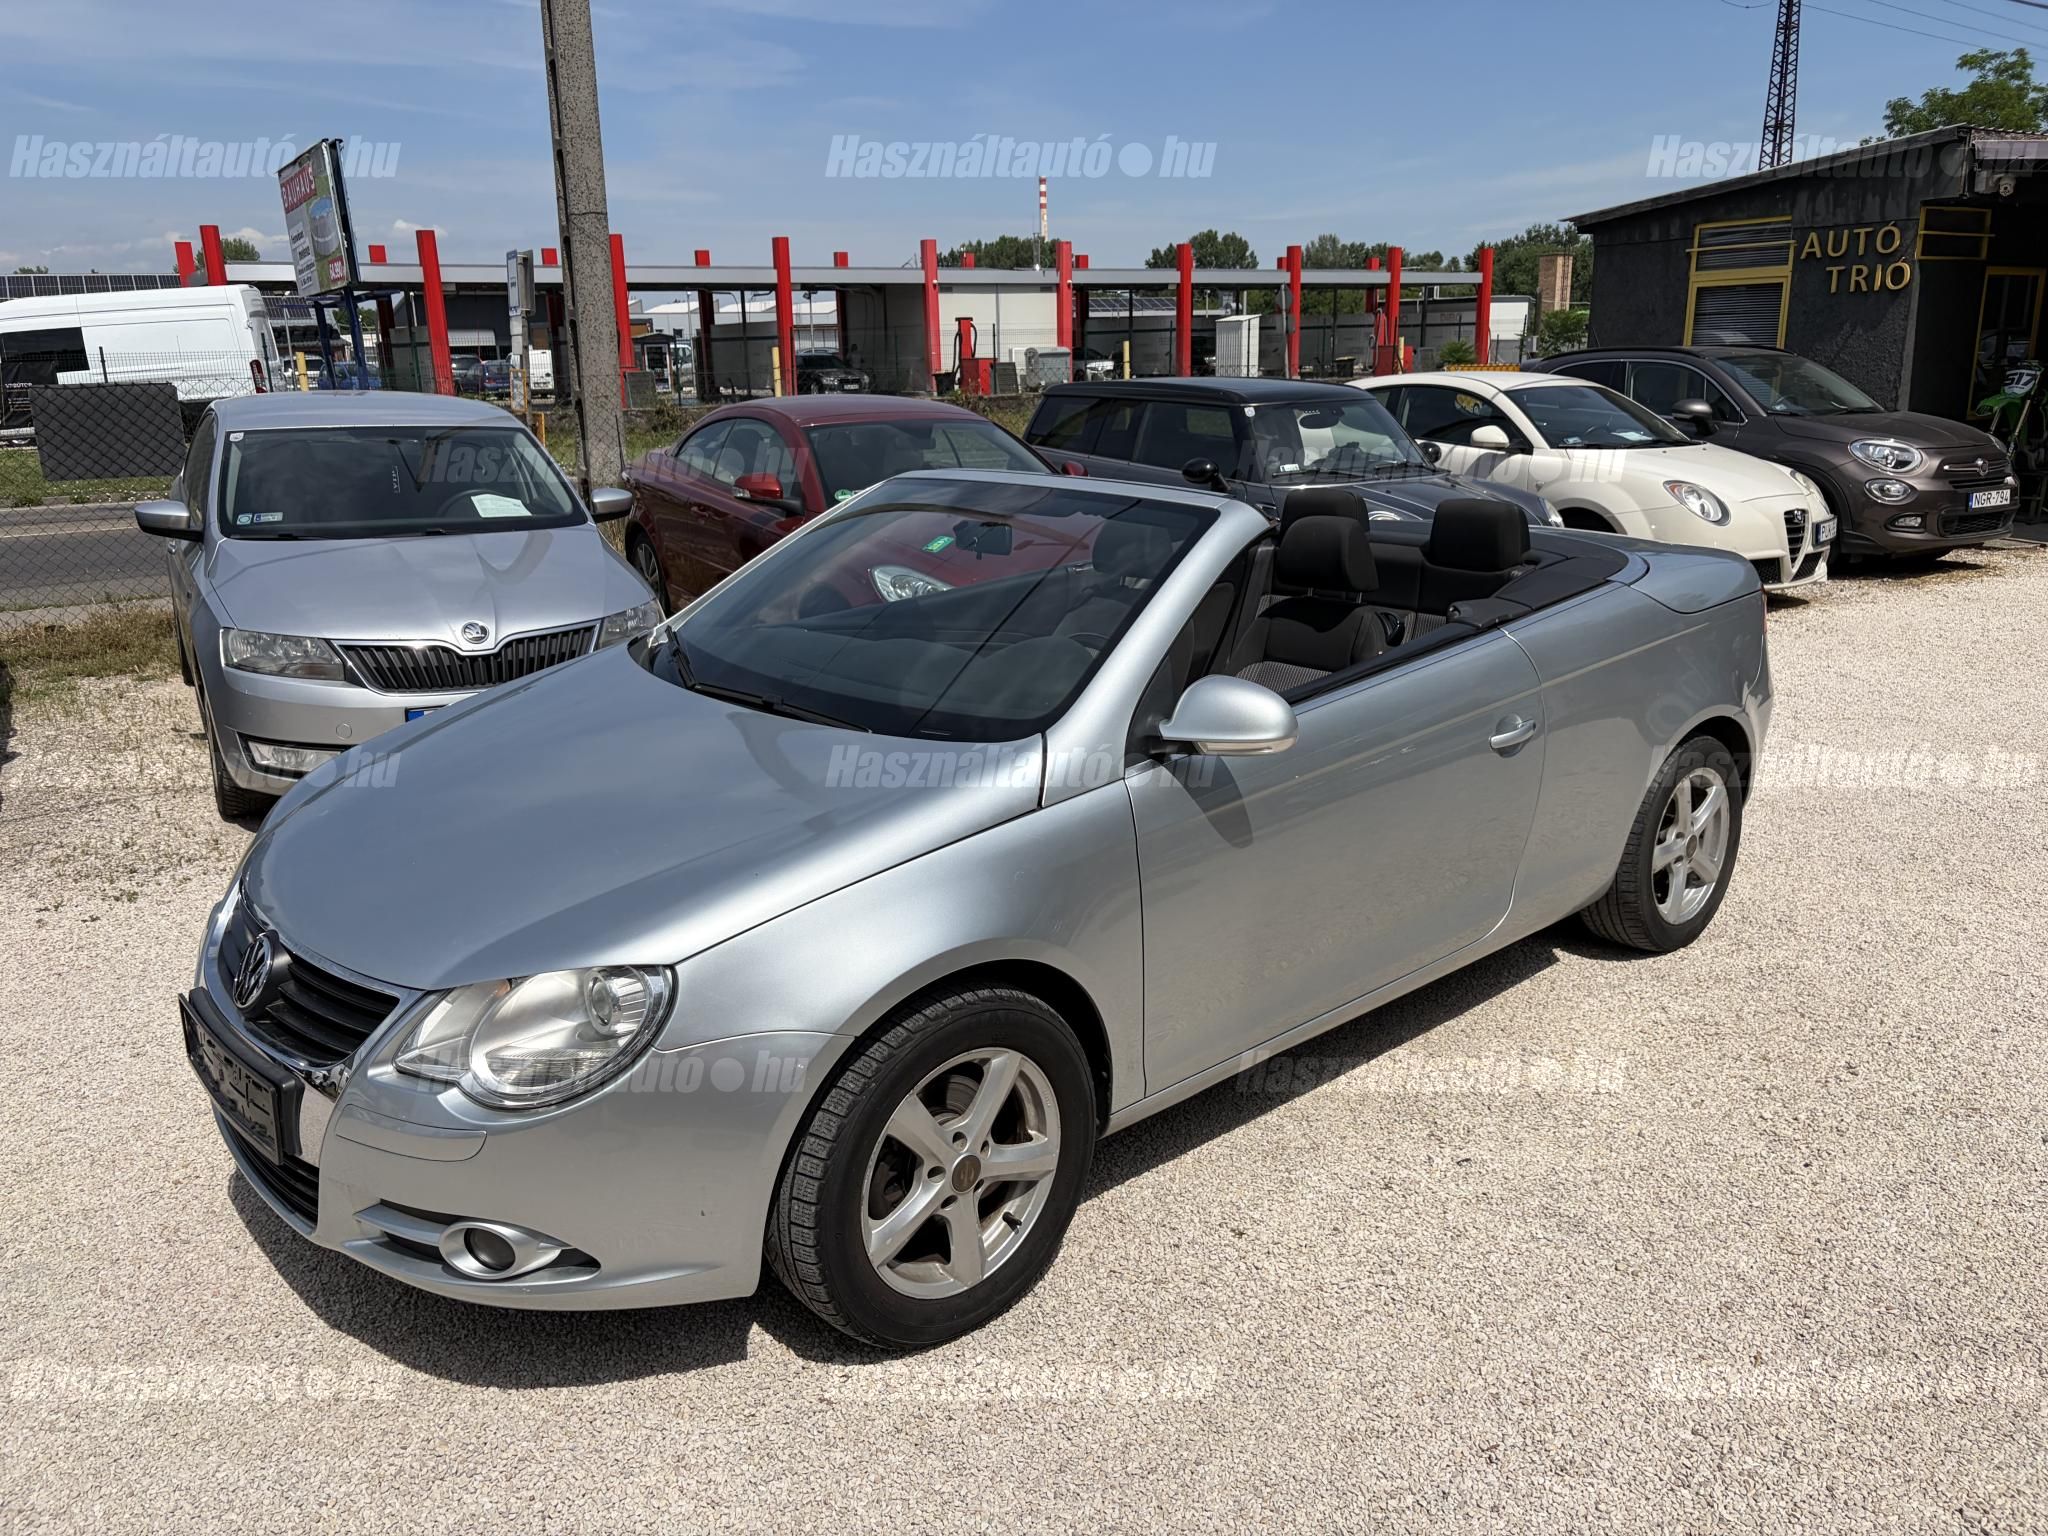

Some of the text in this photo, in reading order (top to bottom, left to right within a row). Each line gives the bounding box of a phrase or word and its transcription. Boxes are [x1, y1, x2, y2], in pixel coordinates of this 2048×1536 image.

[282, 166, 315, 208] BAUHAUS
[1800, 221, 1901, 260] AUTÓ
[1826, 256, 1911, 294] TRIÓ
[1974, 491, 2009, 507] NGR-794
